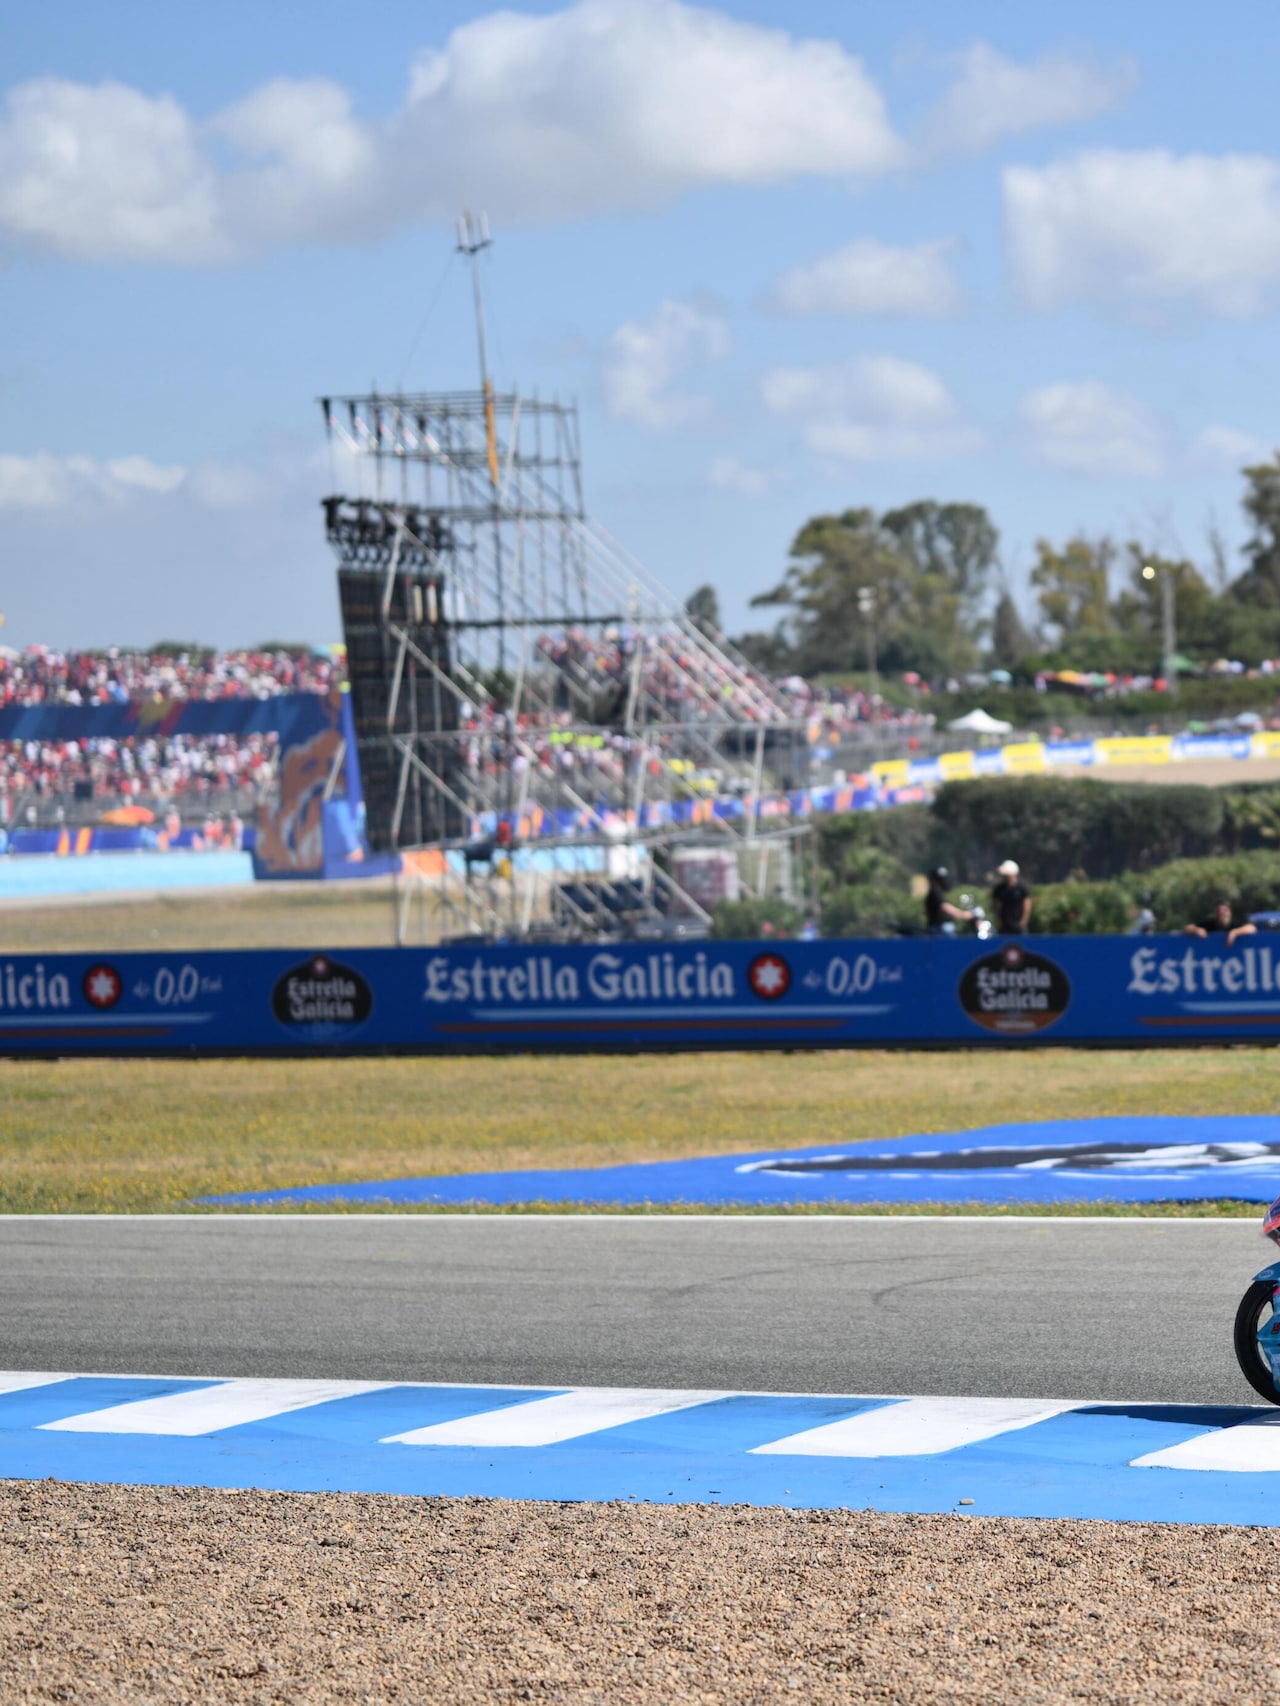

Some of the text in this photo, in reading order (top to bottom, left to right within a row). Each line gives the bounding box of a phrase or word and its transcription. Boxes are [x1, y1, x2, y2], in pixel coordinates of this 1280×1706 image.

[423, 952, 736, 1001] Estrella Galicia
[976, 966, 1051, 989] Estrella
[980, 989, 1049, 1010] Galicia
